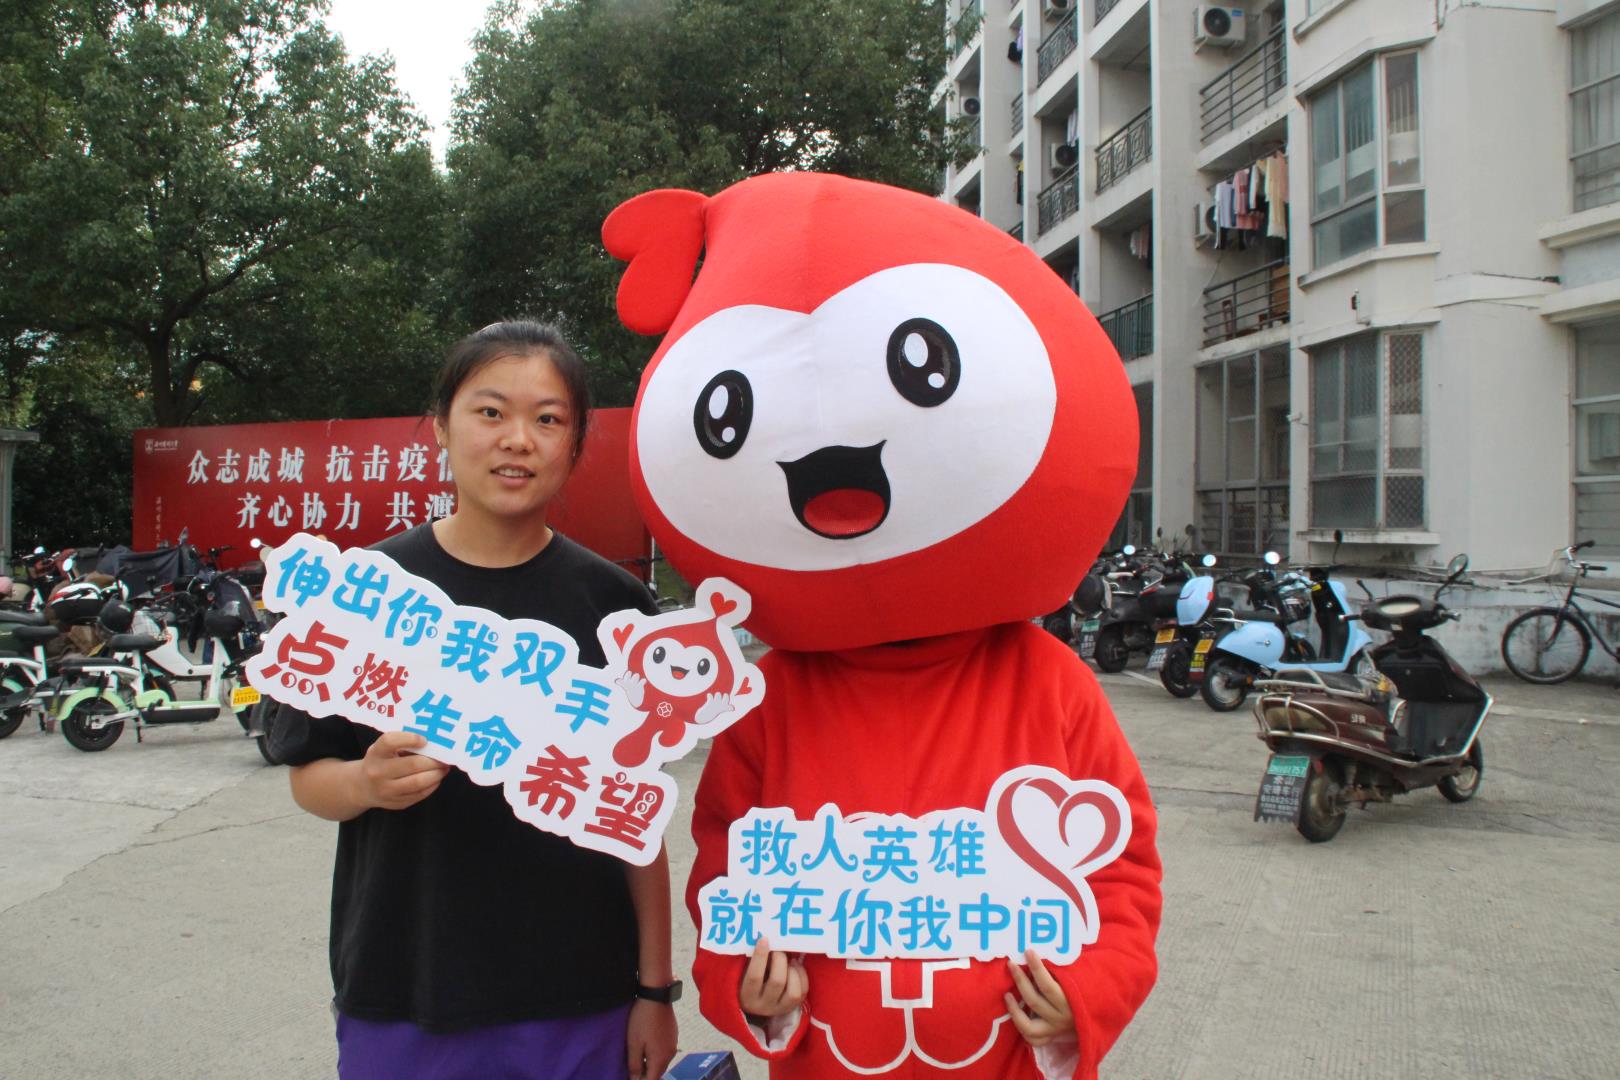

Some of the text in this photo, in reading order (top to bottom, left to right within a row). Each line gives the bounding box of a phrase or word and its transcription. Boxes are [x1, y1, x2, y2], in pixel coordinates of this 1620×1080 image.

[187, 447, 304, 484] 众志成城
[237, 491, 360, 531] 齐心协力
[276, 548, 611, 734] 伸出你我双手
[261, 620, 665, 851] 点燃生命希望
[740, 815, 987, 882] 救人英雄
[707, 881, 1070, 955] 就在你我中间
